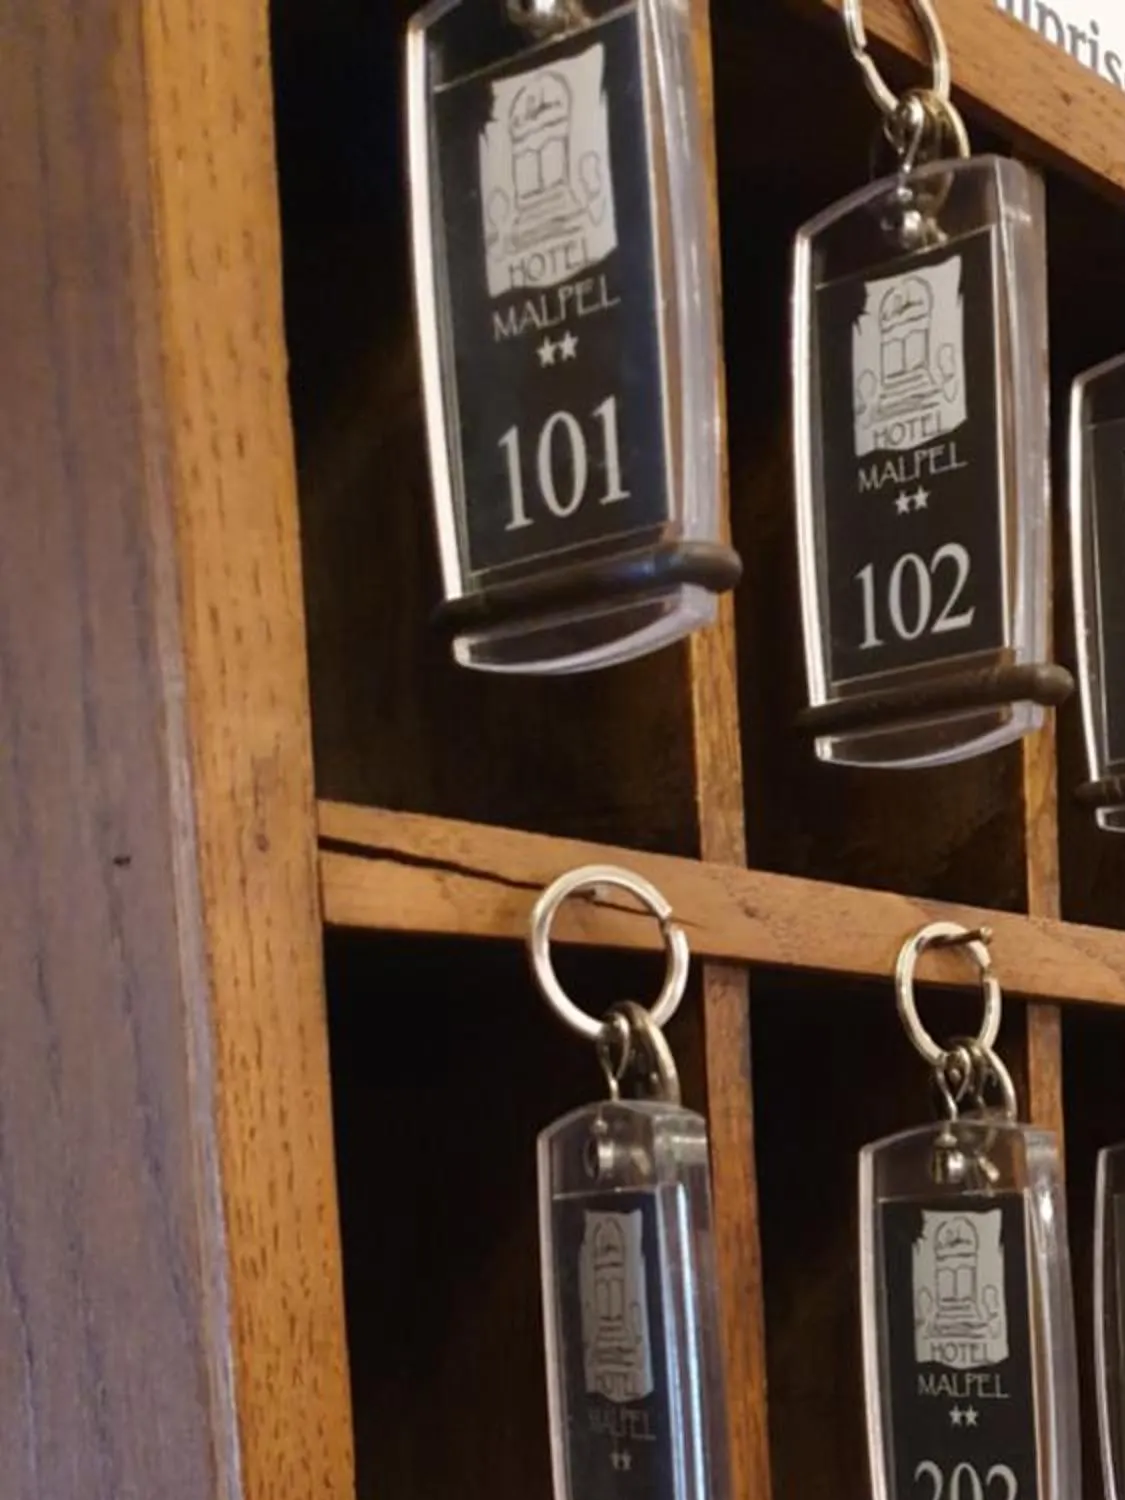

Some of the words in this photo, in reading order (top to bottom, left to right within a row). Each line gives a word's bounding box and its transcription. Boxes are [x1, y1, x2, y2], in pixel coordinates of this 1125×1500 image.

[508, 236, 593, 289] HOTEL
[492, 273, 622, 343] MALPEL
[872, 411, 945, 450] HOTEL
[497, 395, 631, 531] 101
[857, 441, 968, 493] MALPEL
[853, 542, 977, 650] 102
[917, 1372, 1011, 1399] MALPEL
